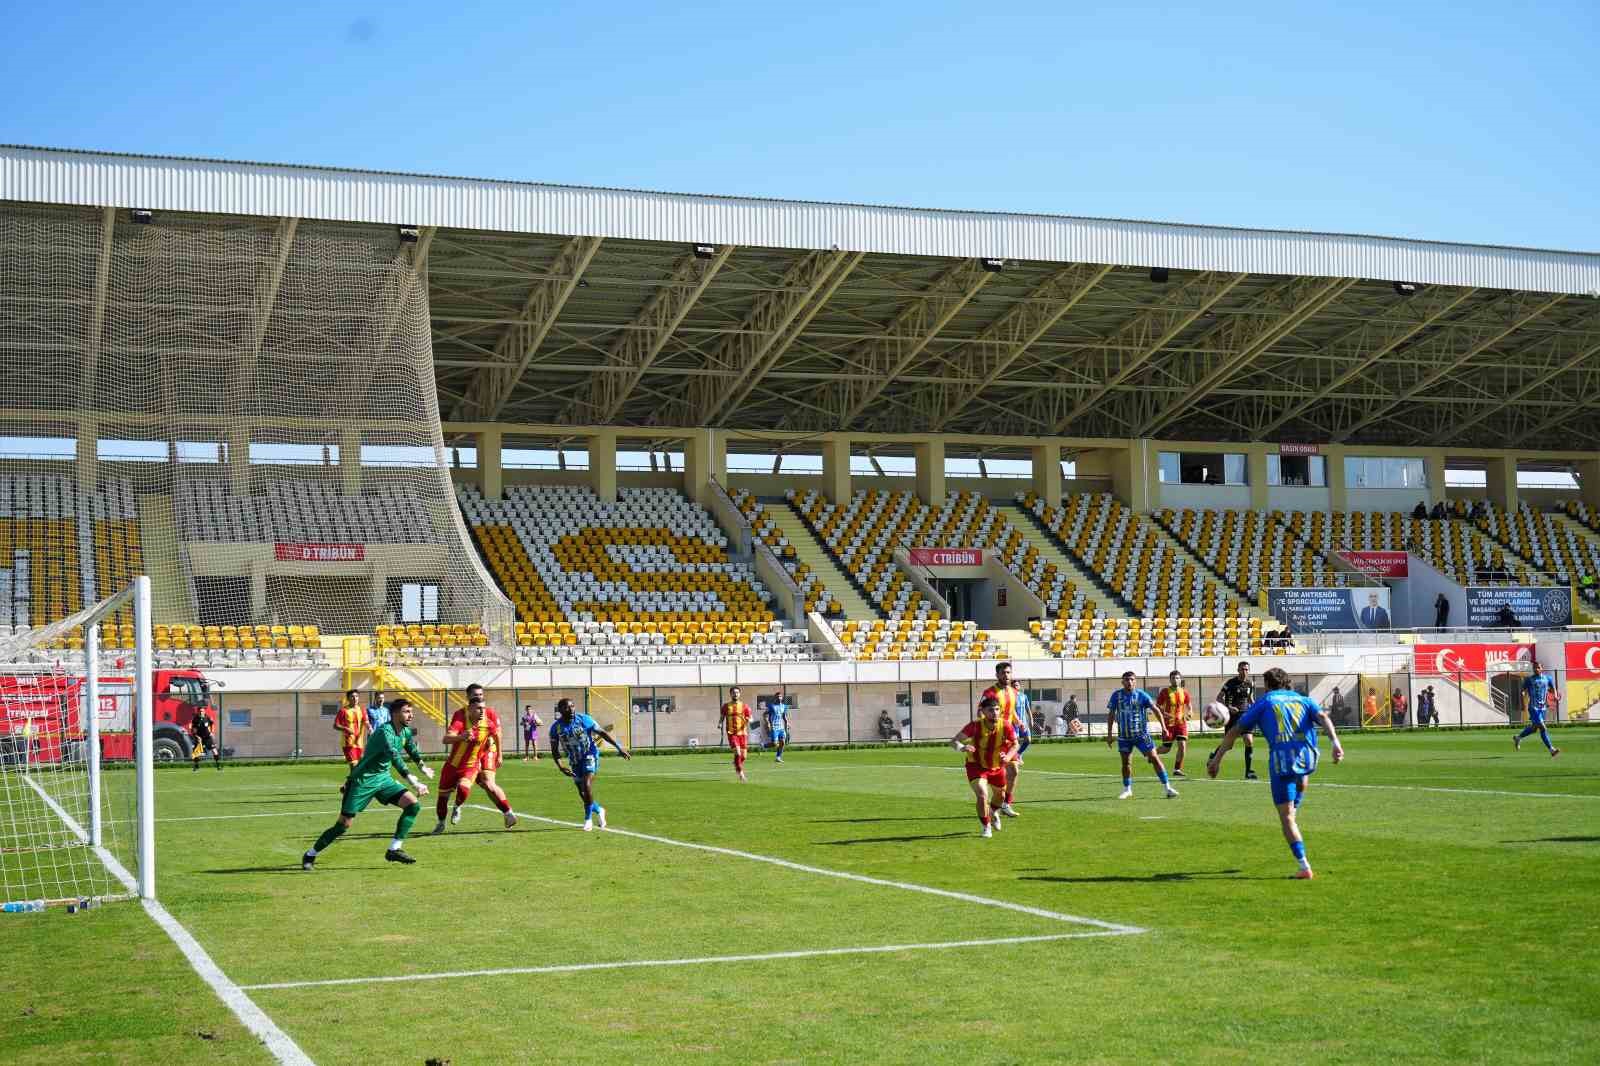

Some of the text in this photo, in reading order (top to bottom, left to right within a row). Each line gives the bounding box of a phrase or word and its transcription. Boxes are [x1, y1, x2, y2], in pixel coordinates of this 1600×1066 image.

[933, 551, 976, 564] C TRİBÜN
[1273, 701, 1303, 742] 17
